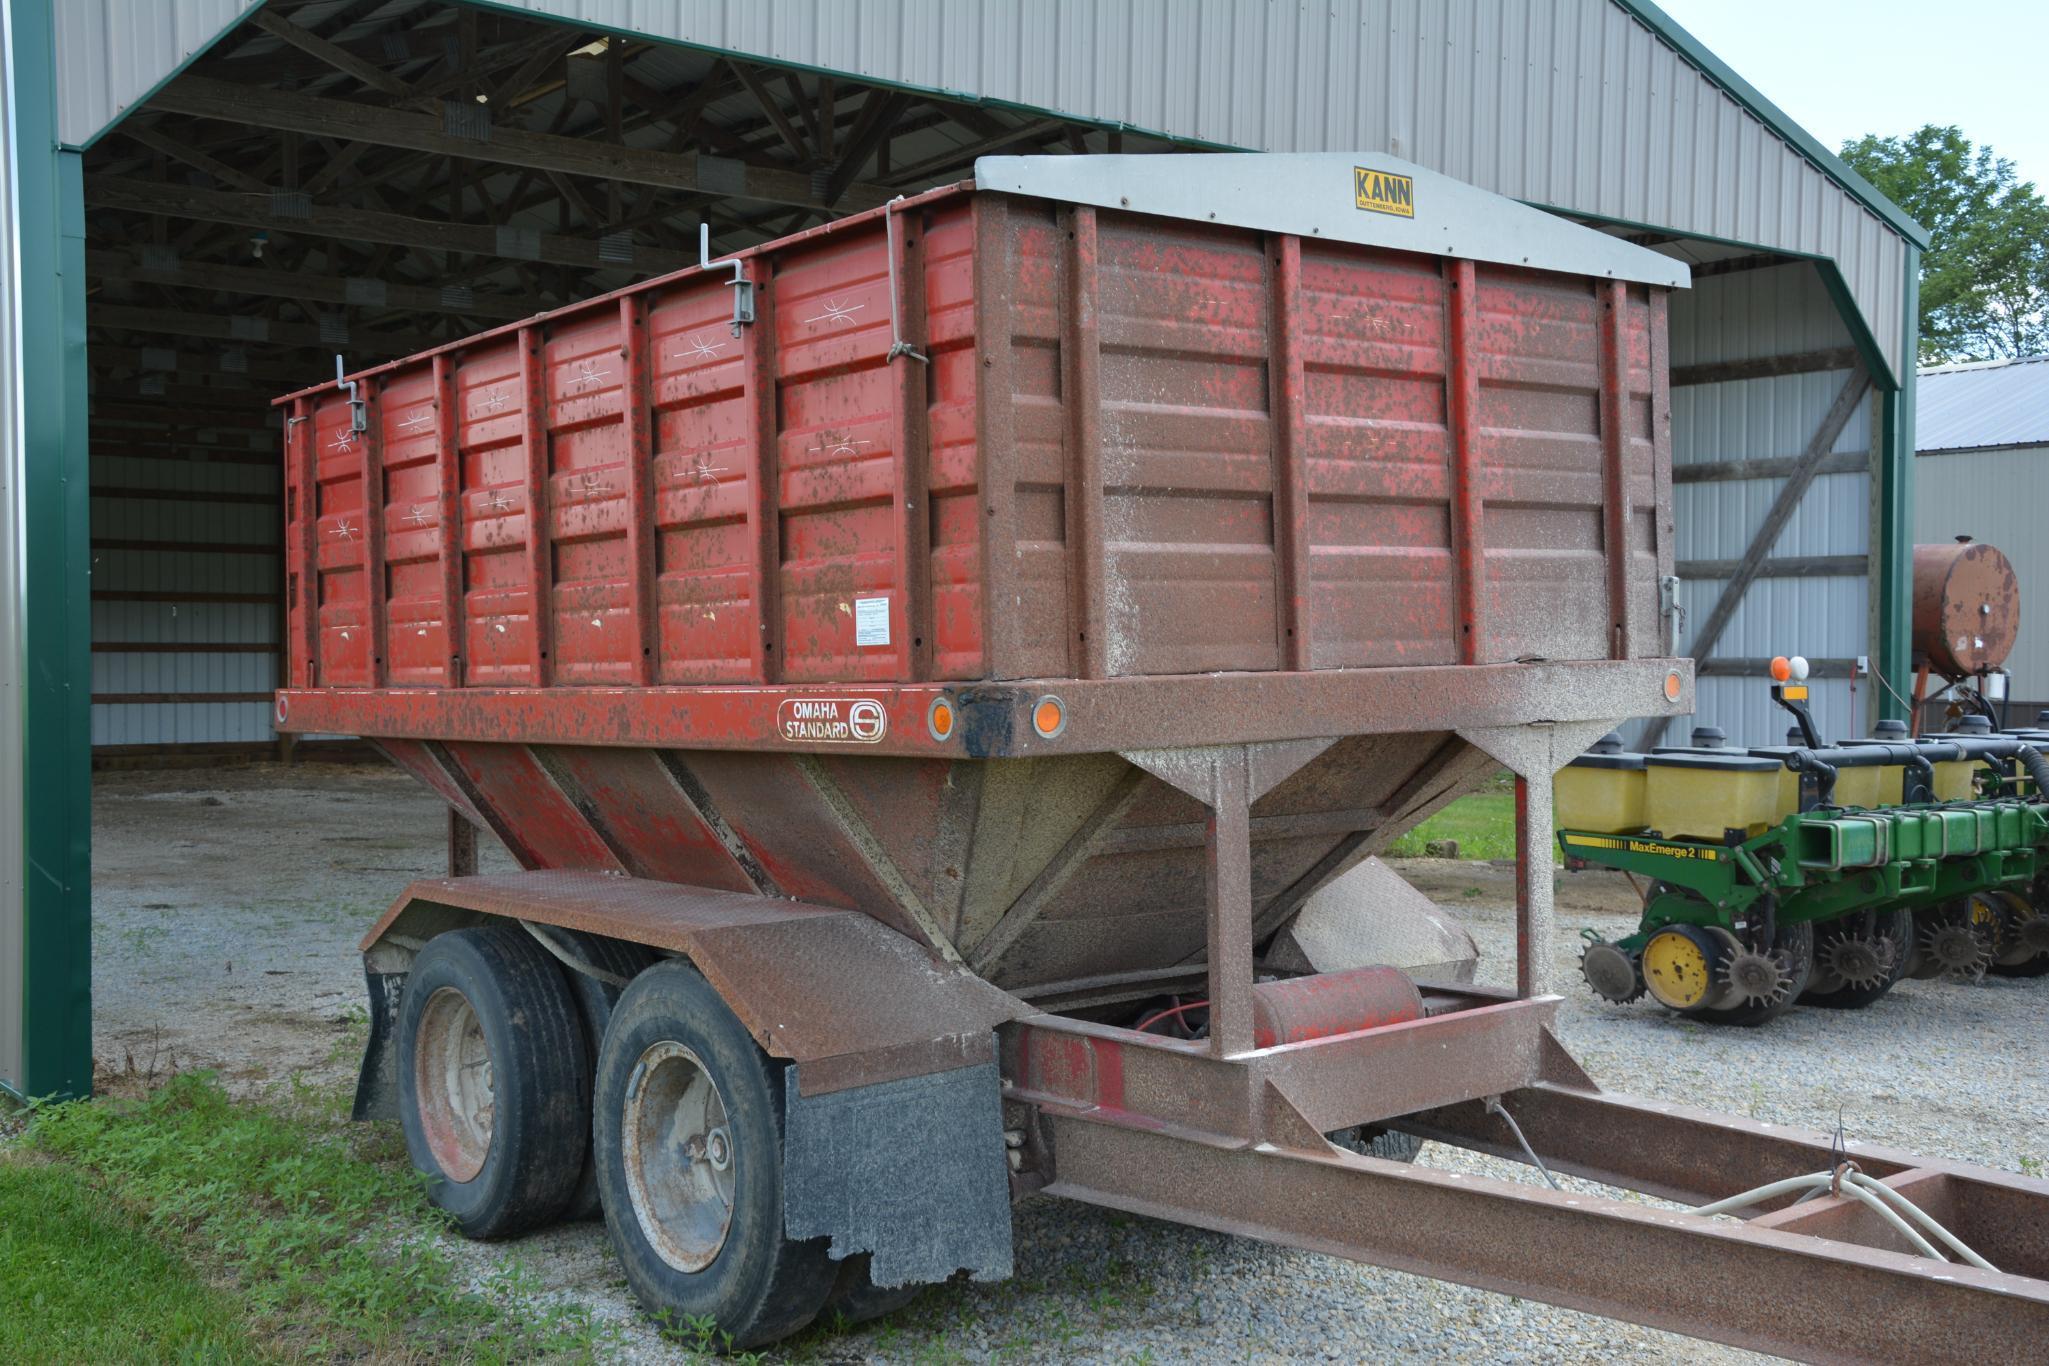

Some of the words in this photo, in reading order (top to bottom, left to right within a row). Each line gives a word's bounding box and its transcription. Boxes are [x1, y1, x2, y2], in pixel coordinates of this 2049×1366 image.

[1357, 171, 1411, 206] KANN
[1396, 206, 1410, 214] IOWA
[793, 702, 838, 719] OMAHA
[786, 721, 849, 738] STANDARD
[1629, 840, 1687, 858] MaxEmerge
[1687, 847, 1696, 858] 2
